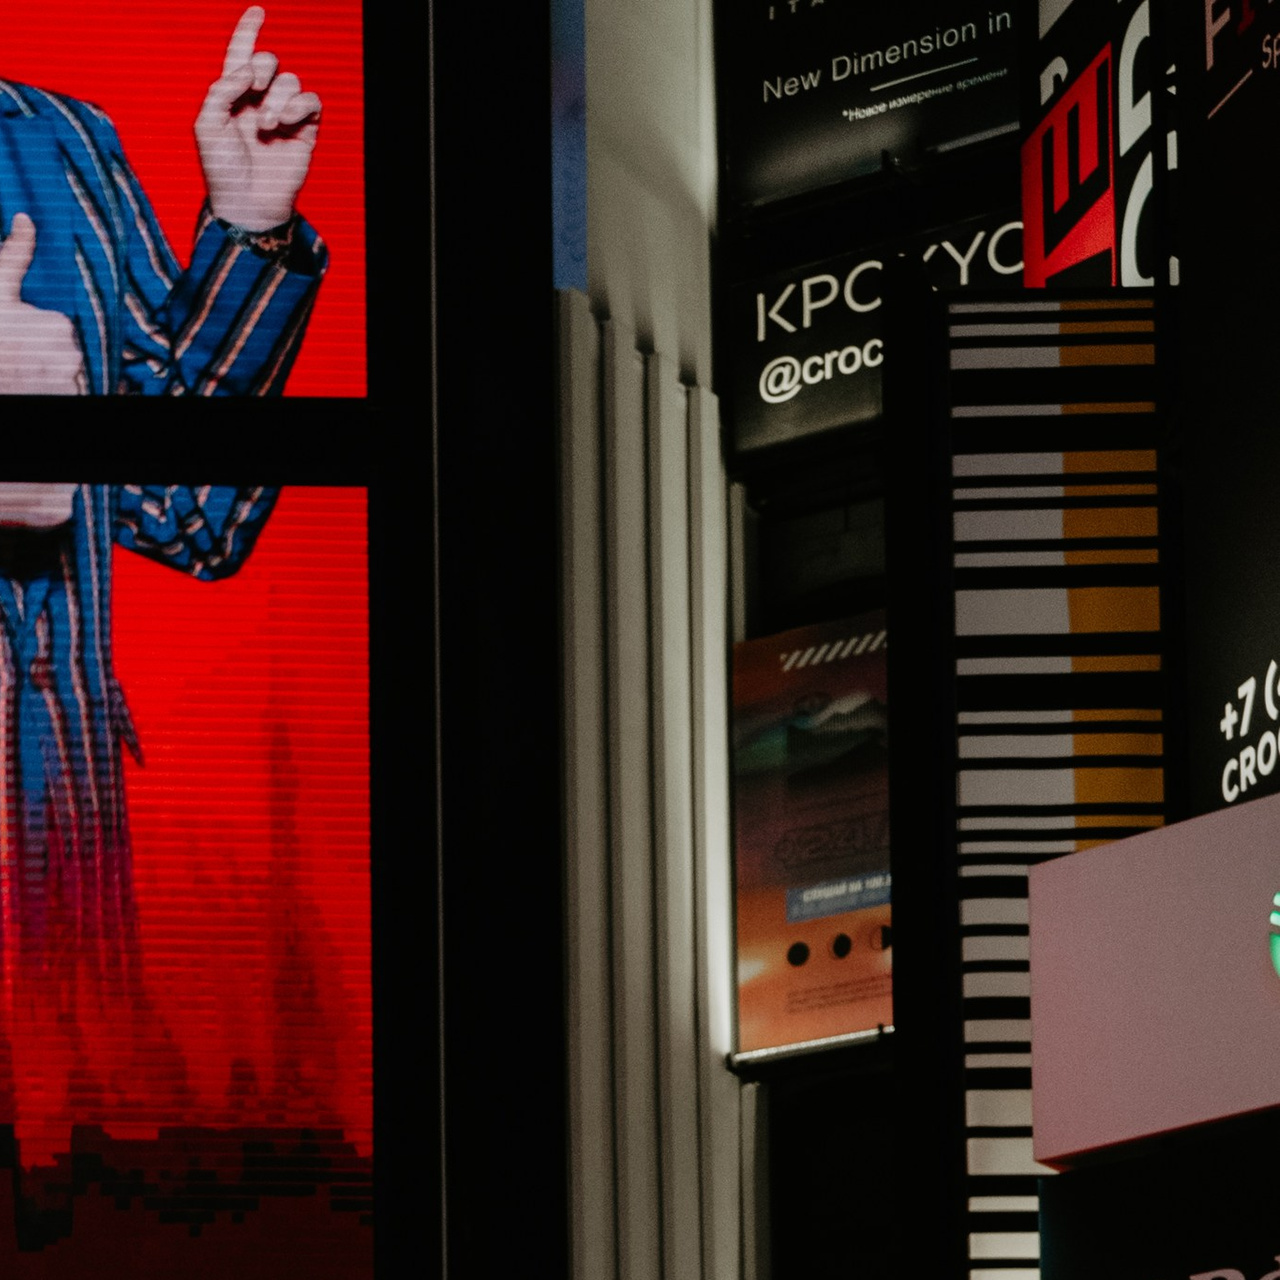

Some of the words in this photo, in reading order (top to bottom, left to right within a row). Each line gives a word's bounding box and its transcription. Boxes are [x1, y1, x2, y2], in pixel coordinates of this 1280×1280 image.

[762, 69, 822, 103] New
[831, 21, 978, 82] Dimension
[988, 10, 1013, 35] in
[1219, 676, 1257, 741] +7
[1222, 727, 1280, 803] CRO
